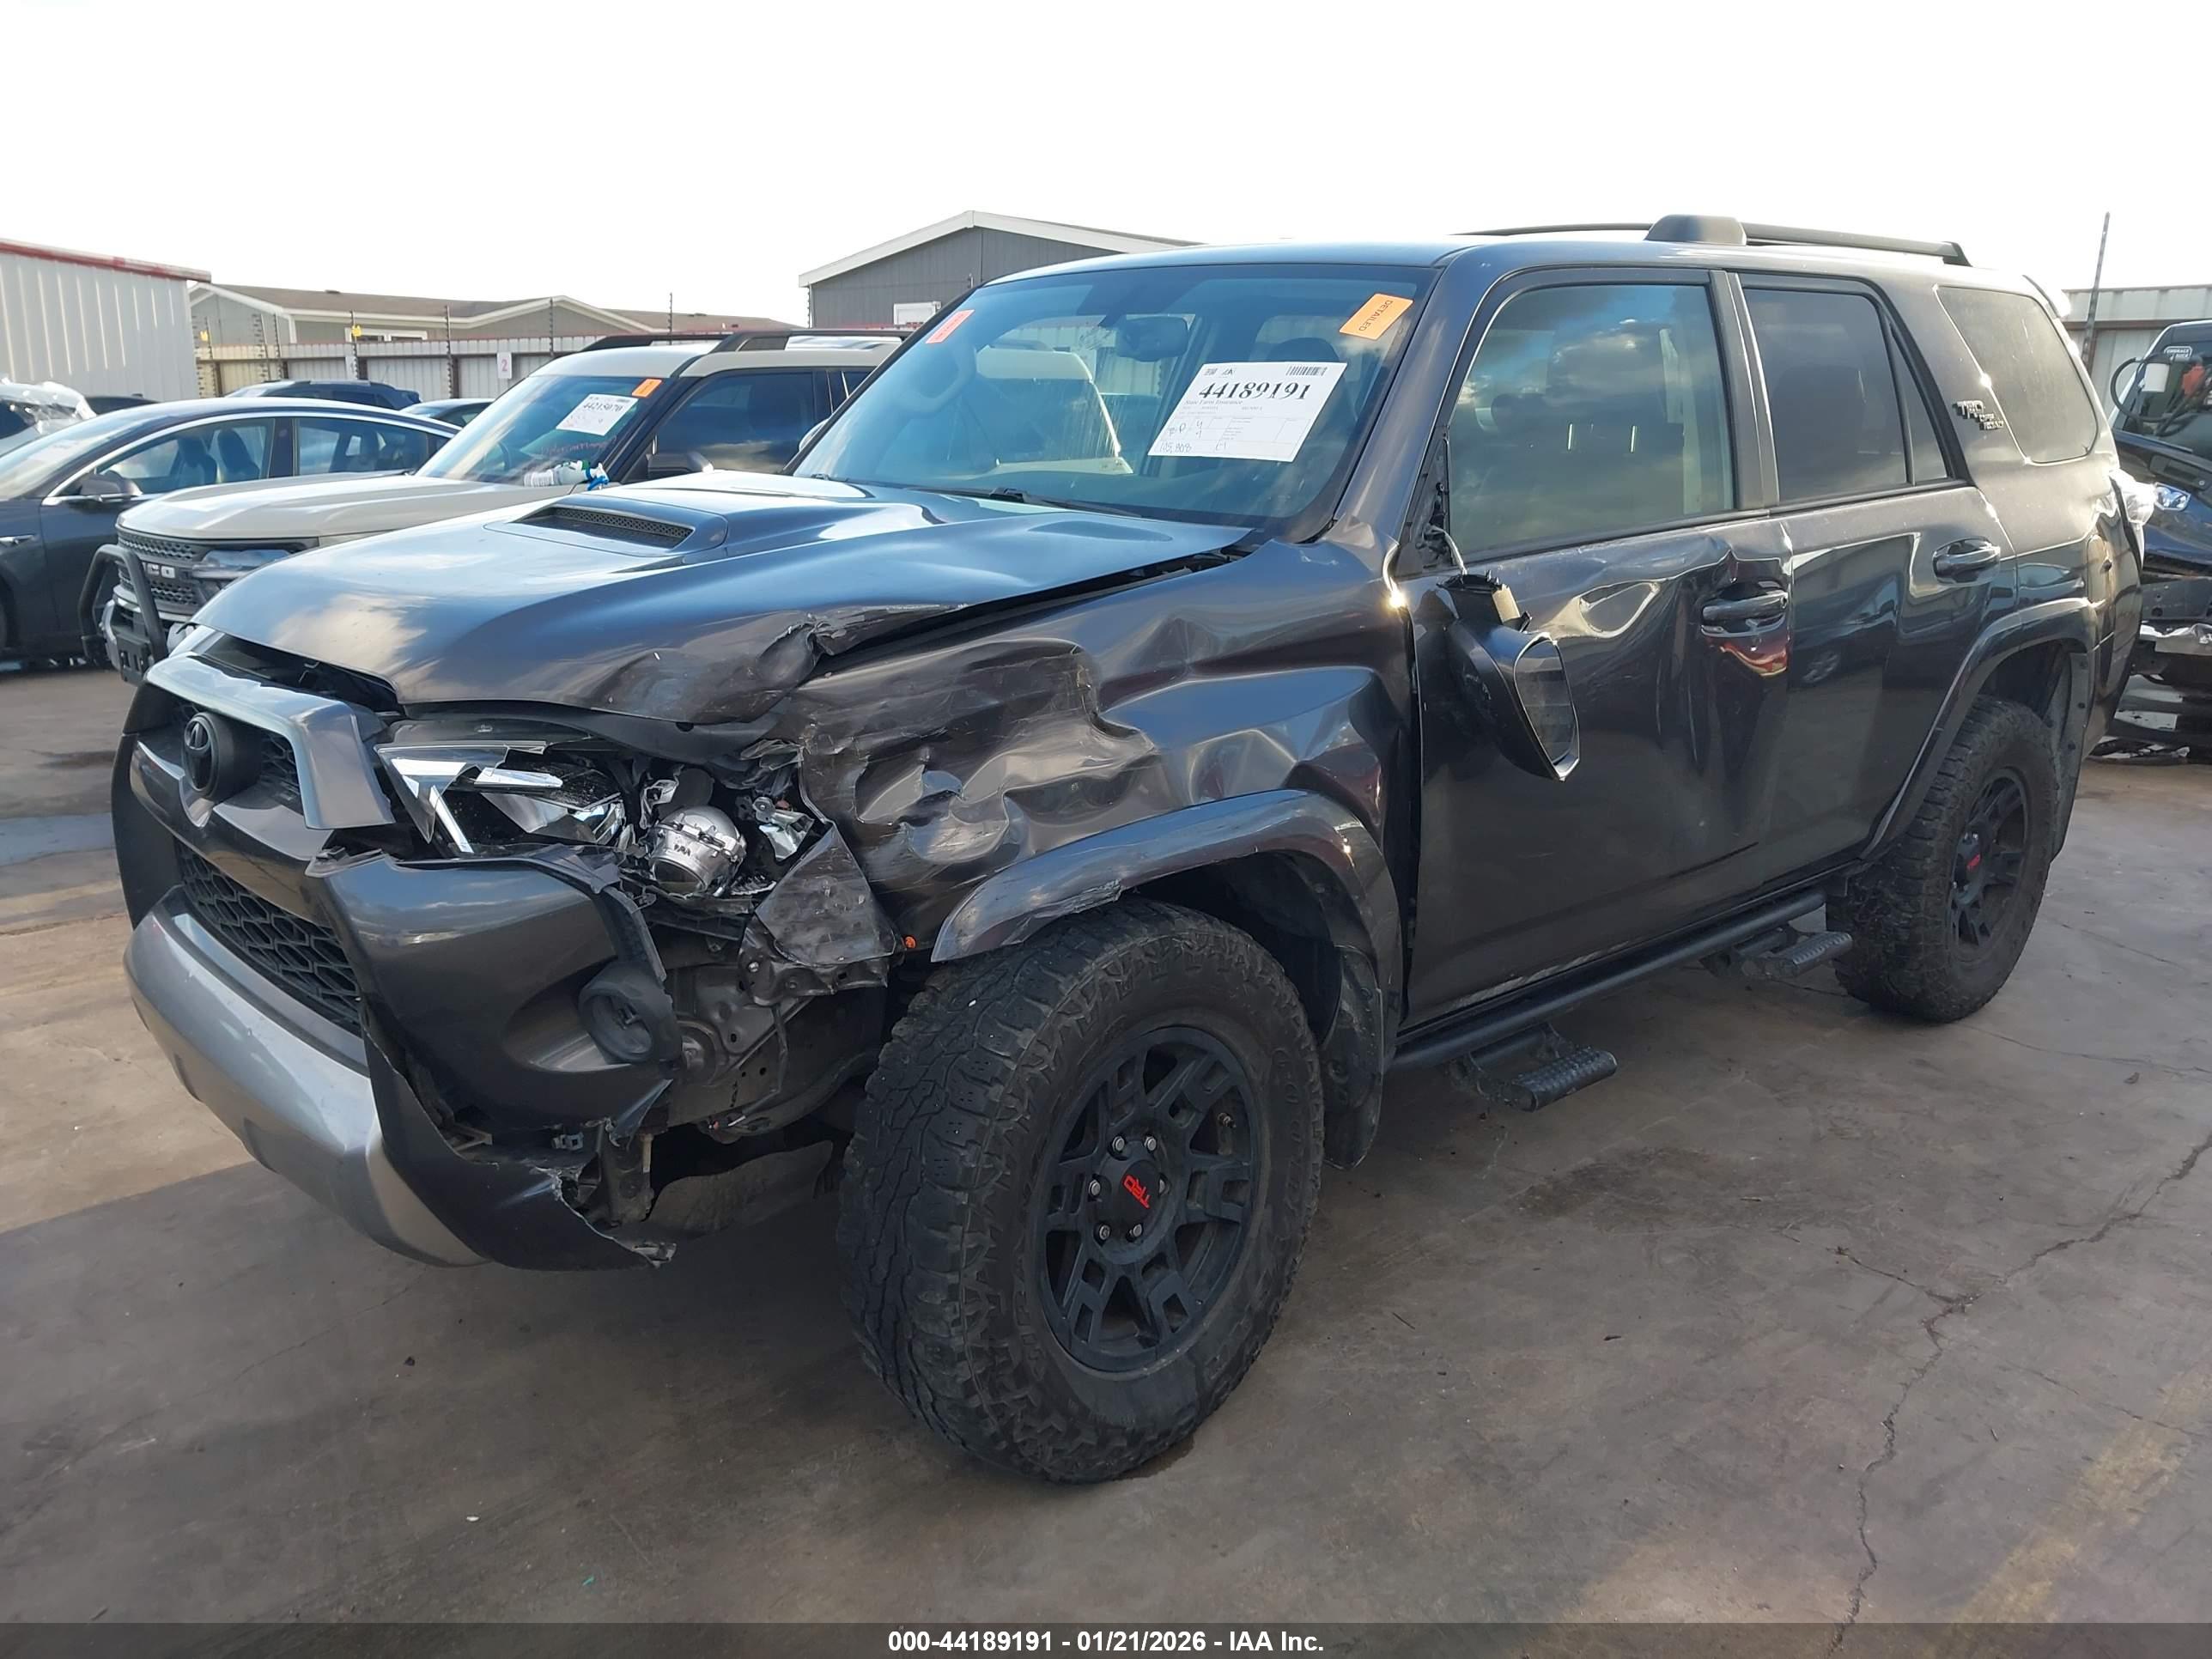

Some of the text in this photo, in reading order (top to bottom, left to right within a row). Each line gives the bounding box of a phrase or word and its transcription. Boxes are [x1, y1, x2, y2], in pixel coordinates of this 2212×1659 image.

[1358, 300, 1393, 331] DETAILED
[501, 359, 508, 372] 2
[1199, 381, 1311, 399] 44189191
[1123, 1174, 1152, 1210] TRD
